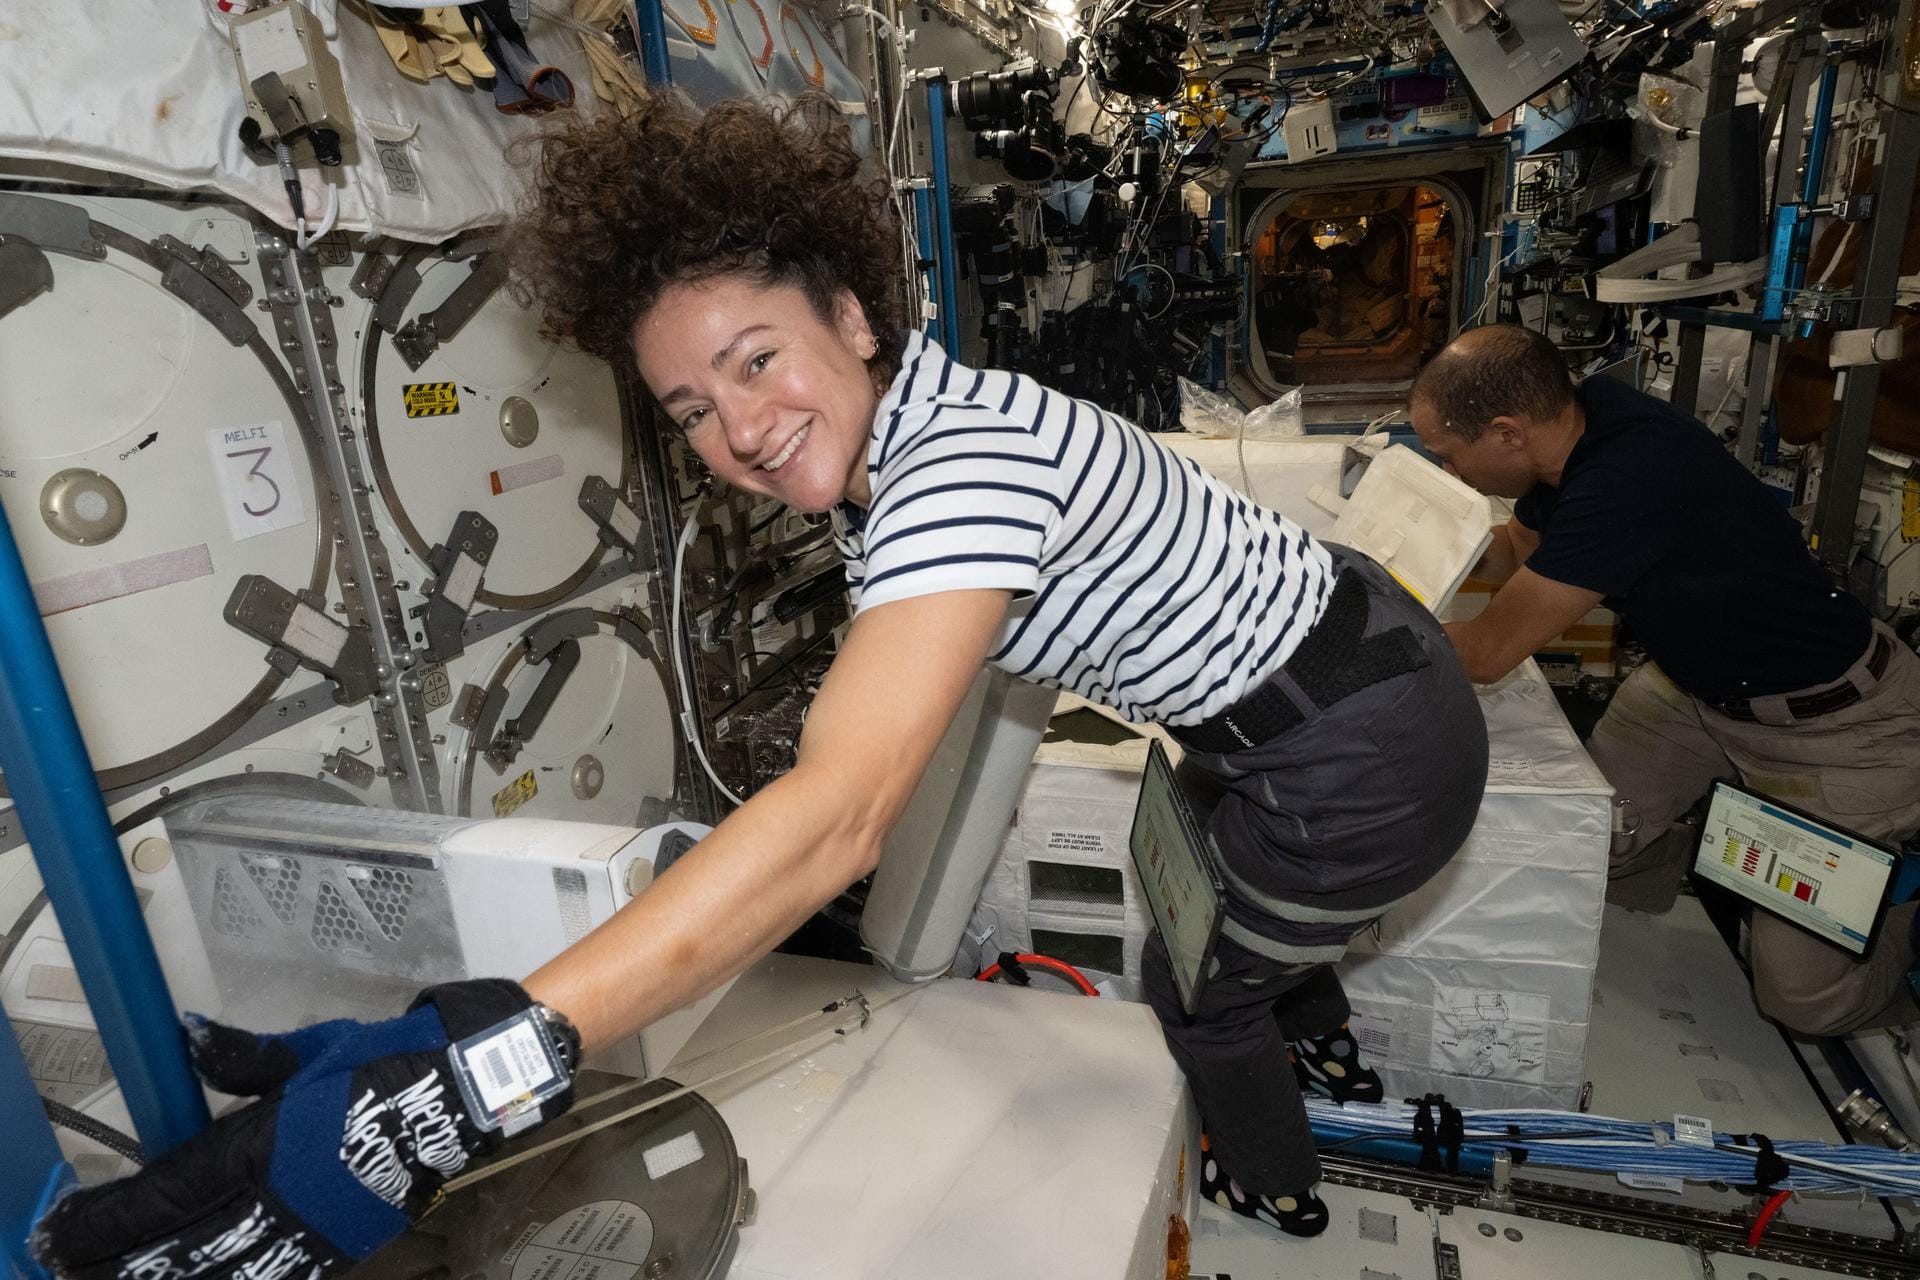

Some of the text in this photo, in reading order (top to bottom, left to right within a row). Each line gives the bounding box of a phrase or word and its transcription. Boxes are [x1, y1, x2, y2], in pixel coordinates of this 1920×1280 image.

[224, 426, 268, 444] MELFI
[226, 446, 281, 517] 3
[1224, 720, 1256, 748] ARCADE
[557, 1219, 581, 1246] DEWAR
[593, 1226, 616, 1252] DEWAR
[504, 1230, 534, 1263] DEWAR
